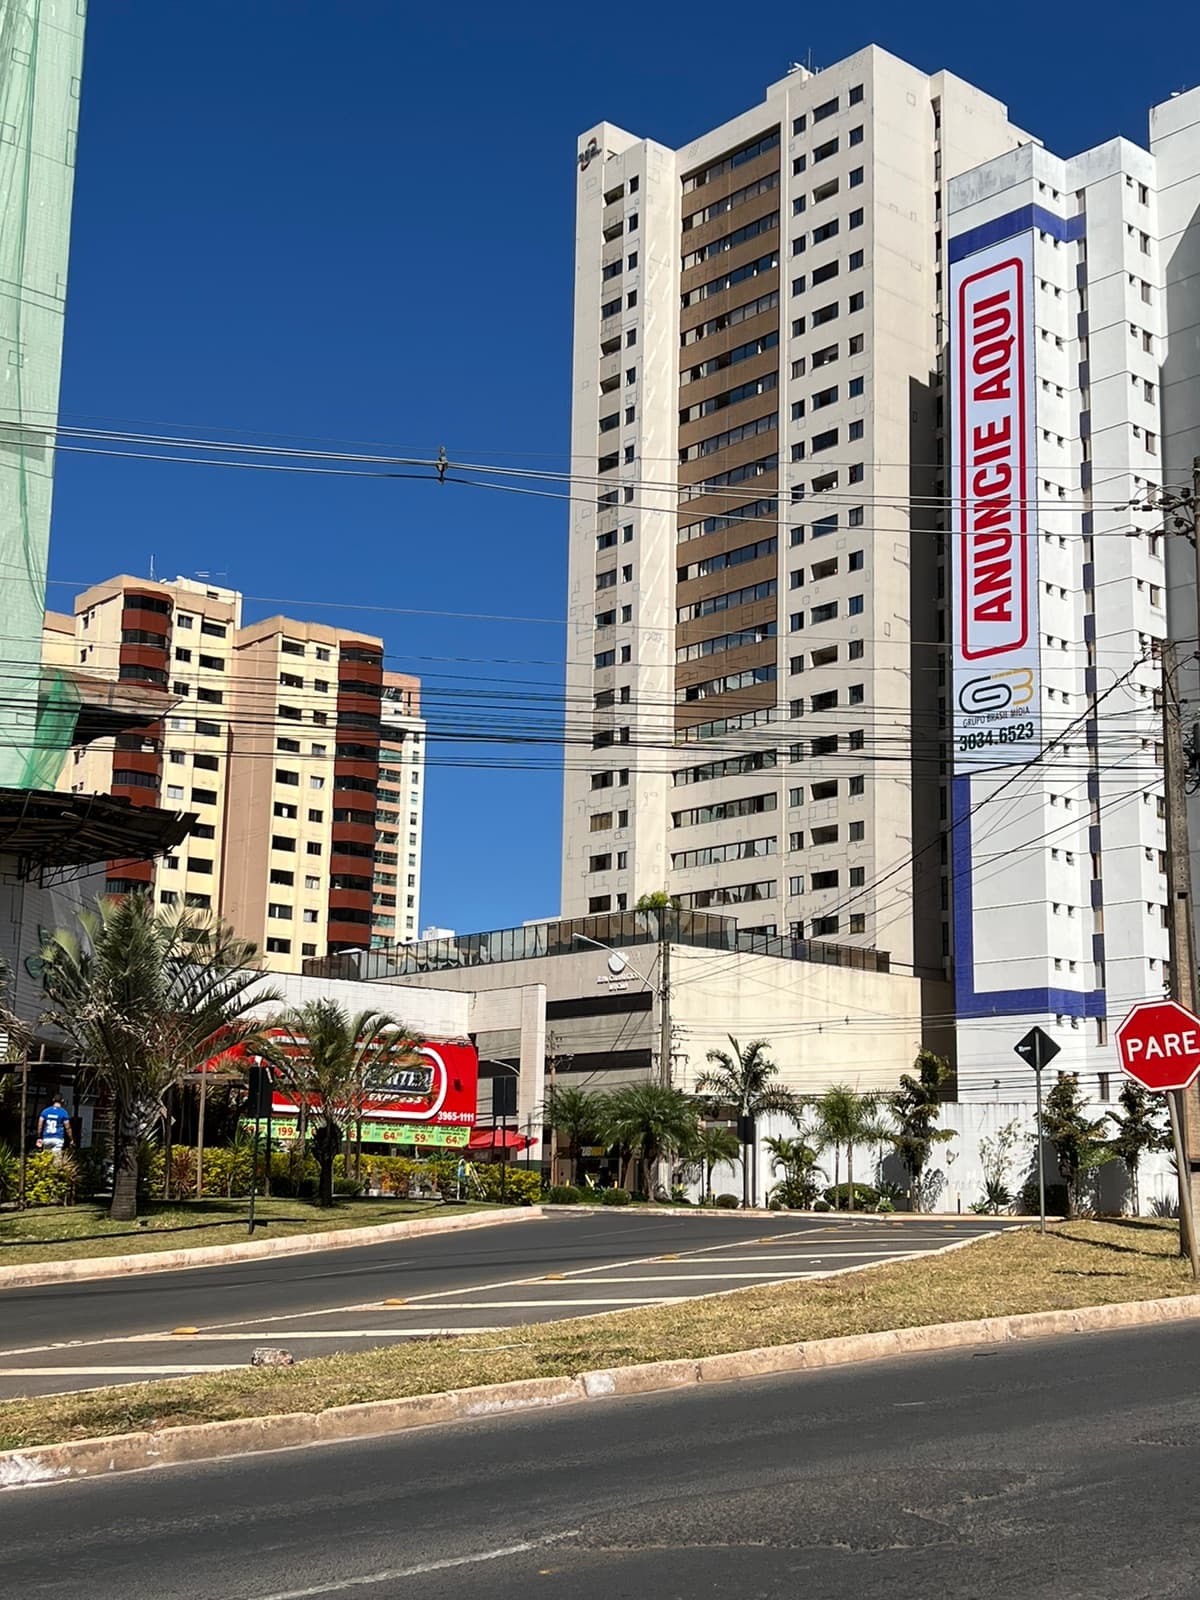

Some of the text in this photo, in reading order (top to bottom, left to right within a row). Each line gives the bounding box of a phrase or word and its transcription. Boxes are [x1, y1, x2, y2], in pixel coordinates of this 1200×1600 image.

[972, 289, 1016, 622] ANUNCIE AQUI
[959, 721, 1034, 752] 3034.6523
[962, 716, 985, 727] GRUPO
[1126, 1030, 1200, 1062] PARE
[437, 1111, 475, 1122] 3965-1111
